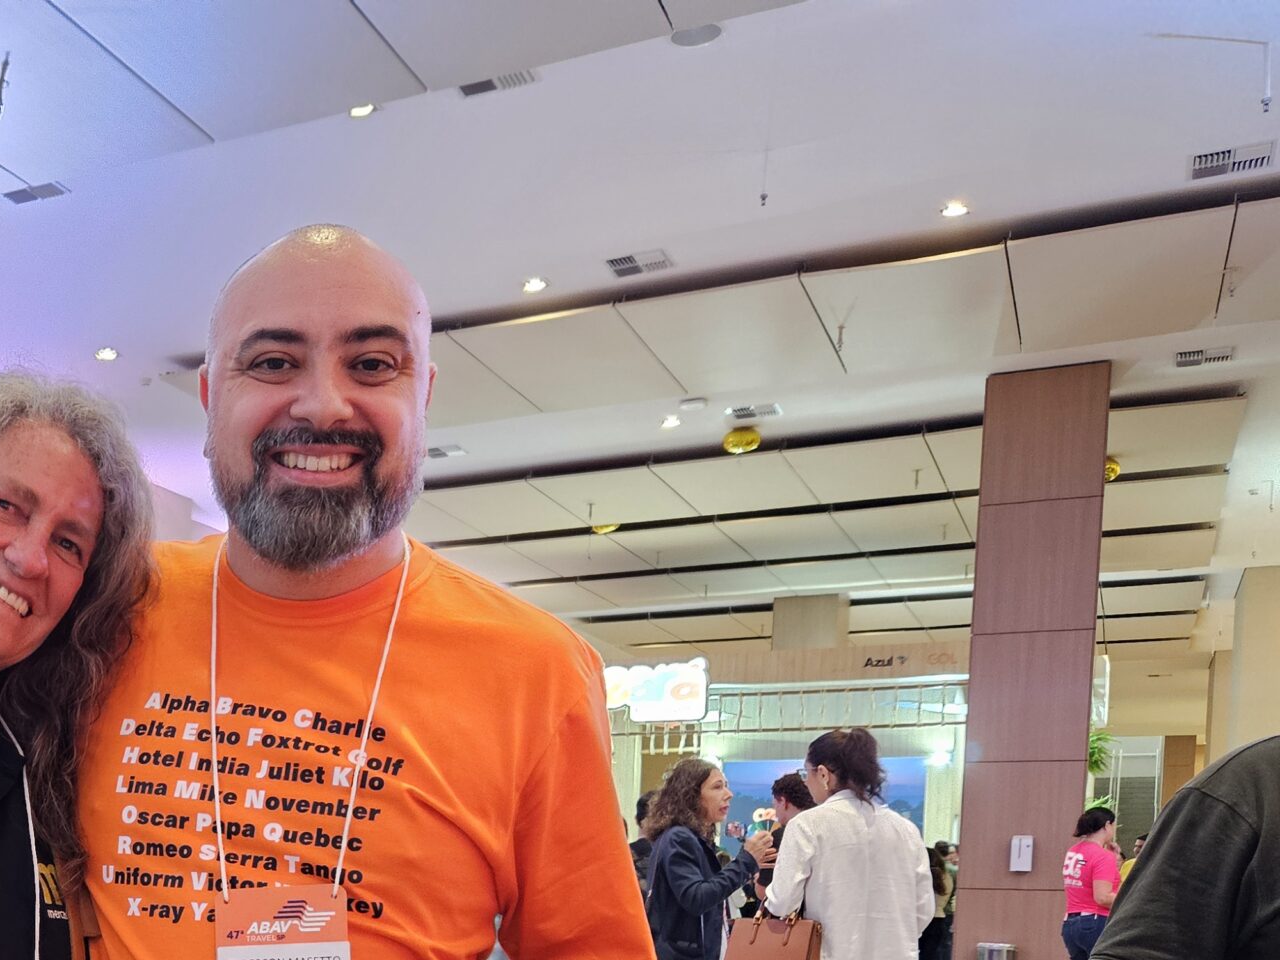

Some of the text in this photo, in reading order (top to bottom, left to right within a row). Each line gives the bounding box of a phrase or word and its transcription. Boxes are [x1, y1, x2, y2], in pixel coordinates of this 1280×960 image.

[863, 652, 958, 668] Azul GOL
[144, 692, 209, 714] Alpha
[216, 697, 287, 722] Bravo
[120, 718, 404, 776] Delta Echo Foxtrot Golf
[122, 746, 385, 791] Hotel India Juliet Klo
[115, 775, 167, 796] Lima
[243, 788, 381, 821] November
[122, 805, 363, 851] Oscar Papa Quebec
[102, 865, 184, 888] Uniform
[117, 835, 192, 859] Romeo
[284, 854, 363, 885] Tango
[127, 897, 185, 924] X-ray
[247, 919, 291, 935] ABAV
